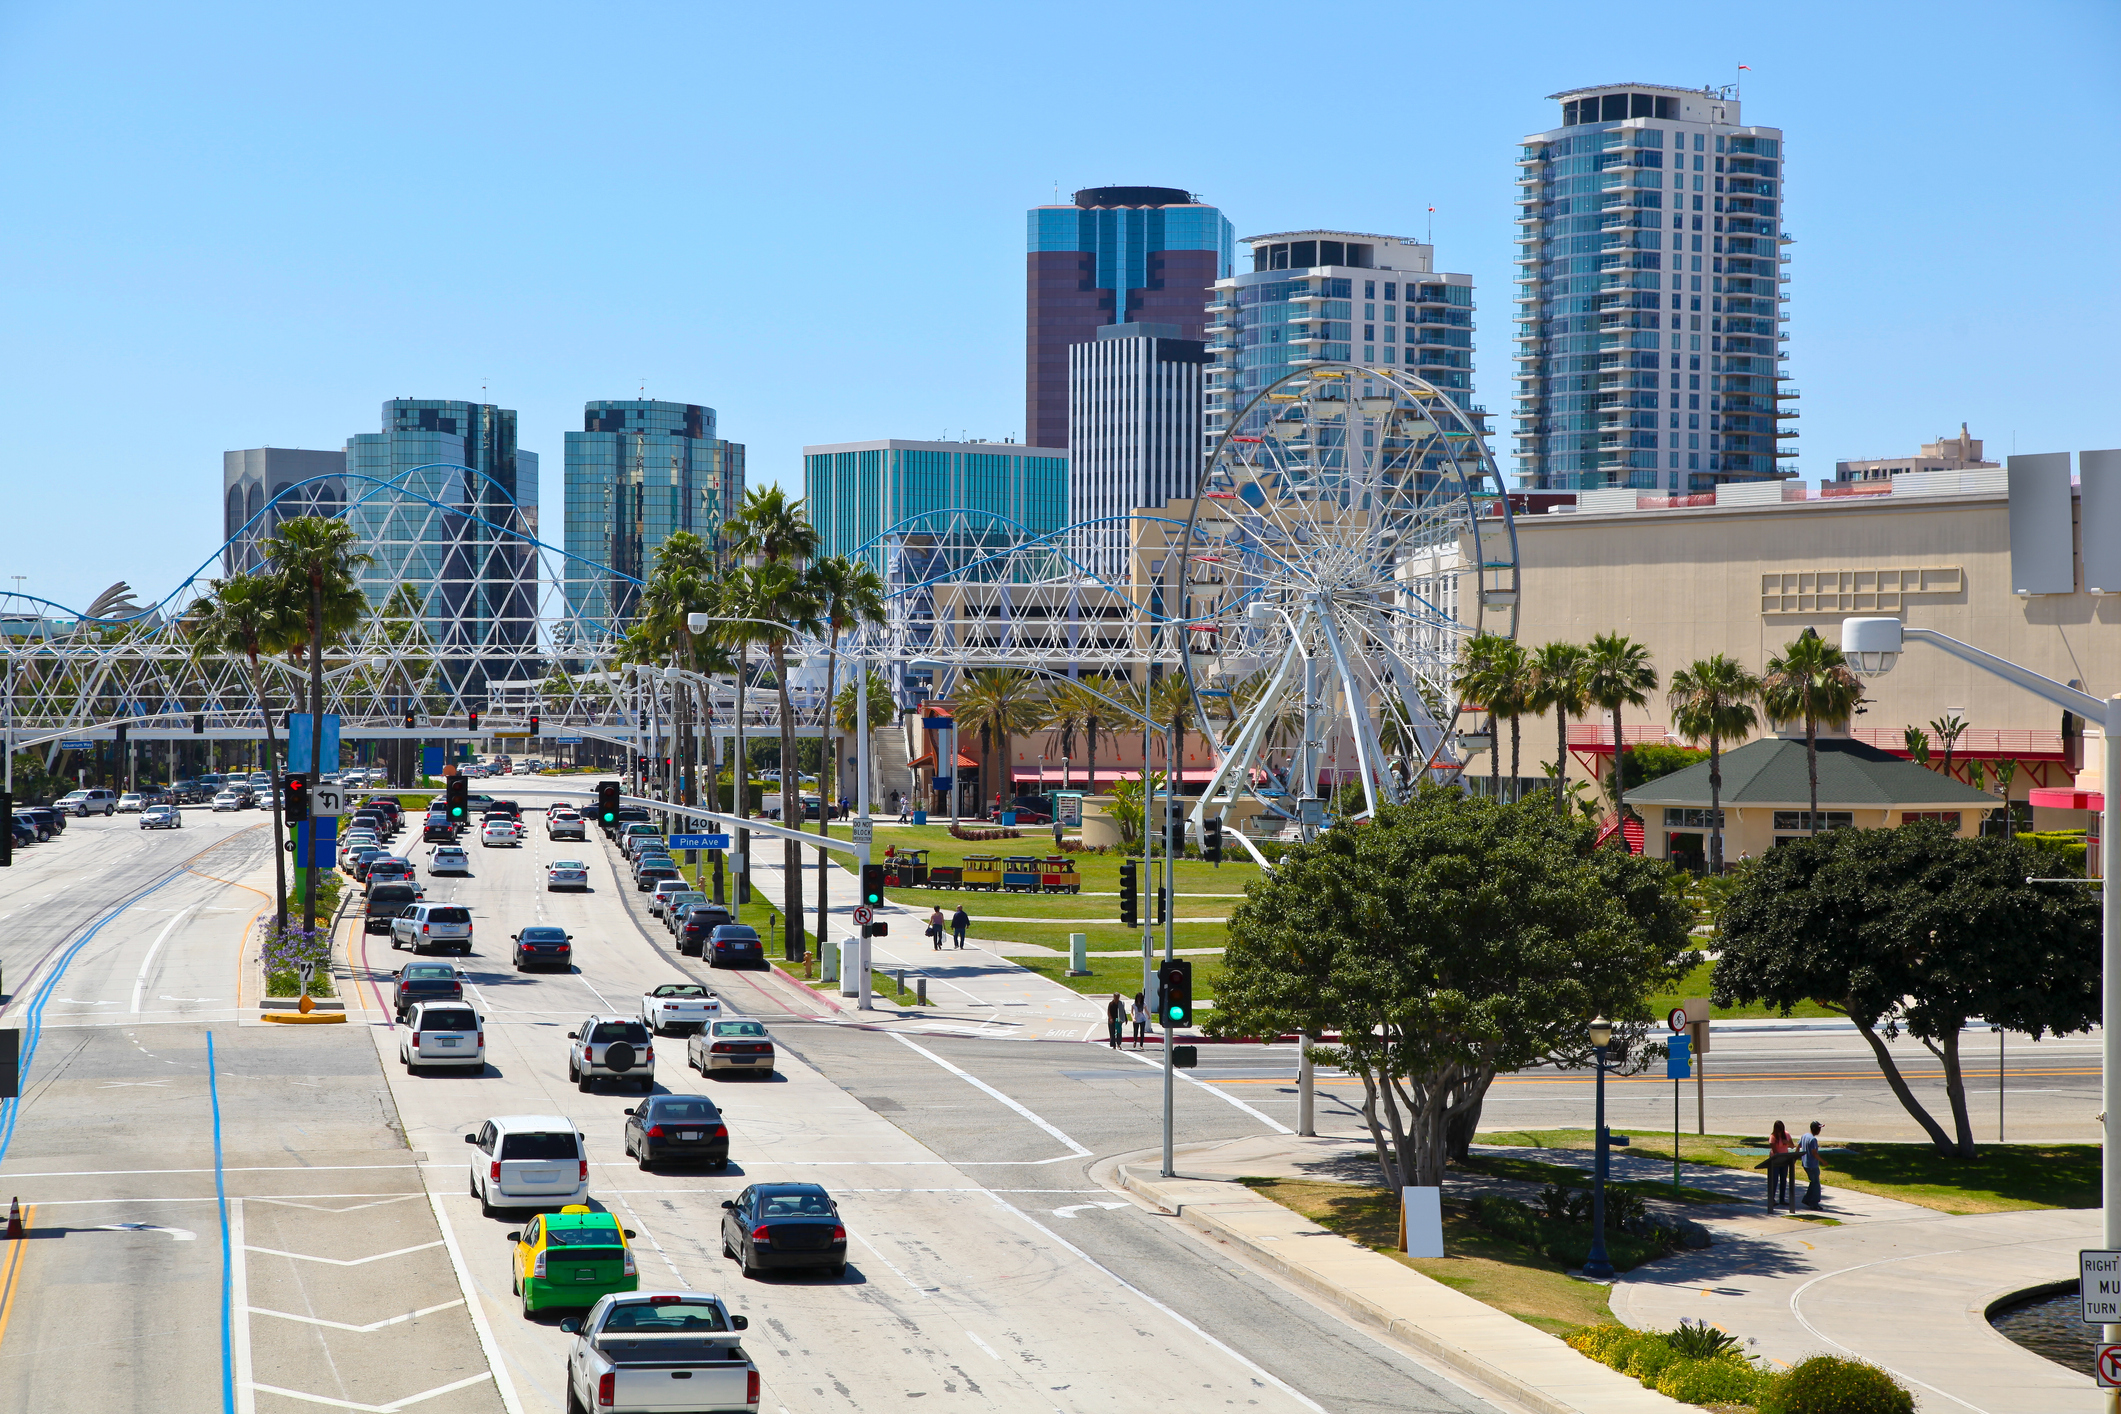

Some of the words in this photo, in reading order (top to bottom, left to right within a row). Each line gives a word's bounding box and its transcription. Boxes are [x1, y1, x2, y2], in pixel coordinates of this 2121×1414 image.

[691, 819, 708, 828] 40
[2085, 1260, 2118, 1271] RIGHT
[2087, 1303, 2116, 1314] TURN
